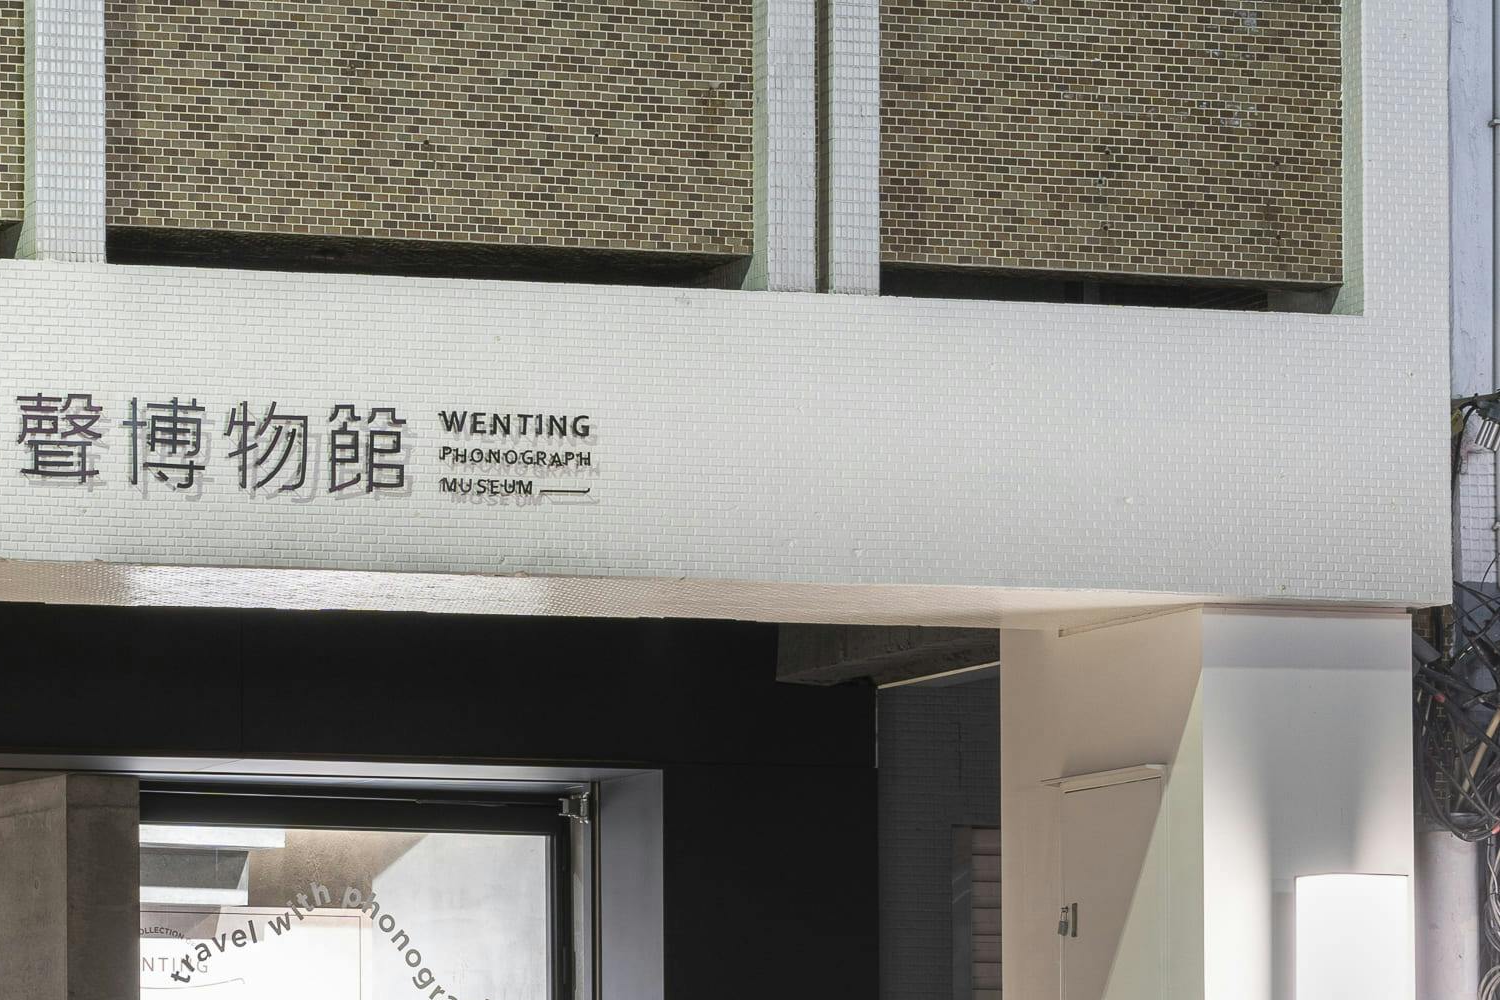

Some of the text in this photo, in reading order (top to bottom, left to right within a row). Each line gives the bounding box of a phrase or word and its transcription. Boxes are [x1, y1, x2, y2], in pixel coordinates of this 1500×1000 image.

[438, 410, 591, 437] WENTING
[439, 446, 592, 467] PHONOGRAPH
[439, 477, 533, 495] MUSEUM
[171, 920, 258, 984] travel
[268, 881, 332, 936] with
